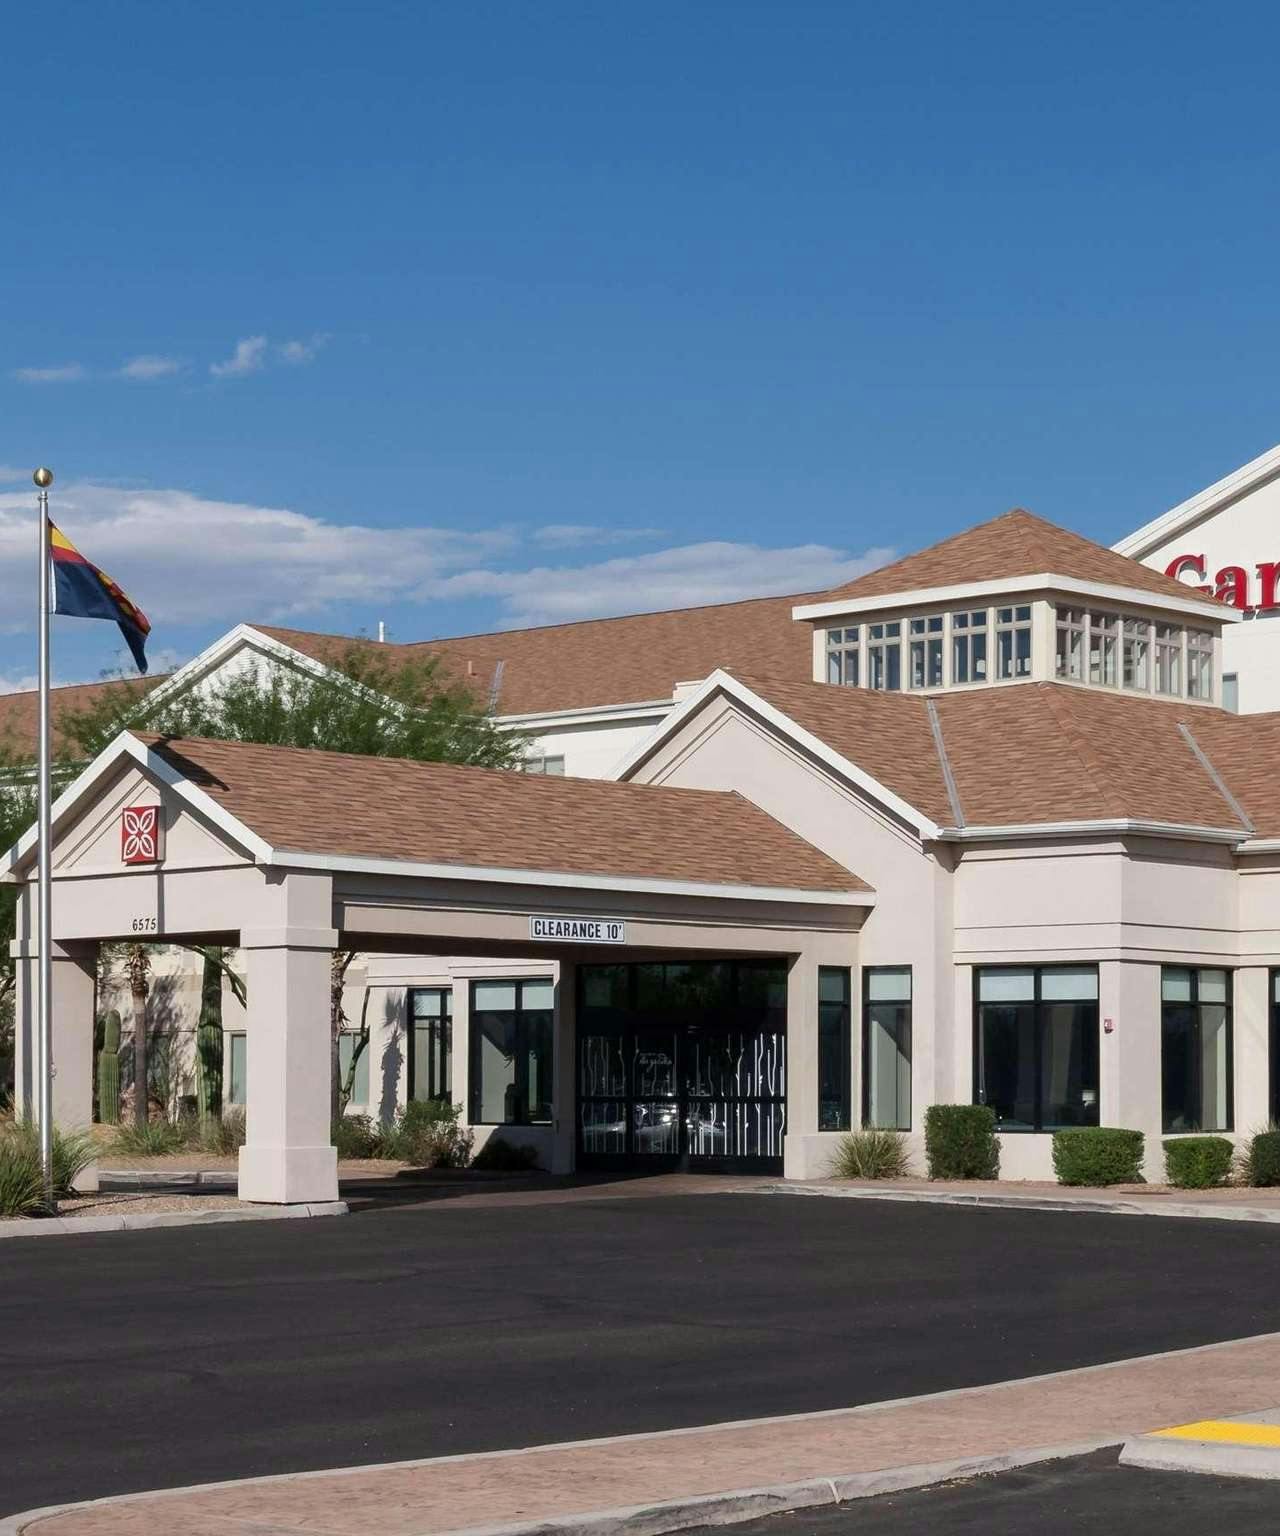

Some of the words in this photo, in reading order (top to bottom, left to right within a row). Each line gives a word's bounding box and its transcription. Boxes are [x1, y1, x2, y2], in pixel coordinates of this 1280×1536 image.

[132, 918, 157, 931] 6575
[534, 920, 601, 938] CLEARANCE
[606, 924, 622, 939] 10'
